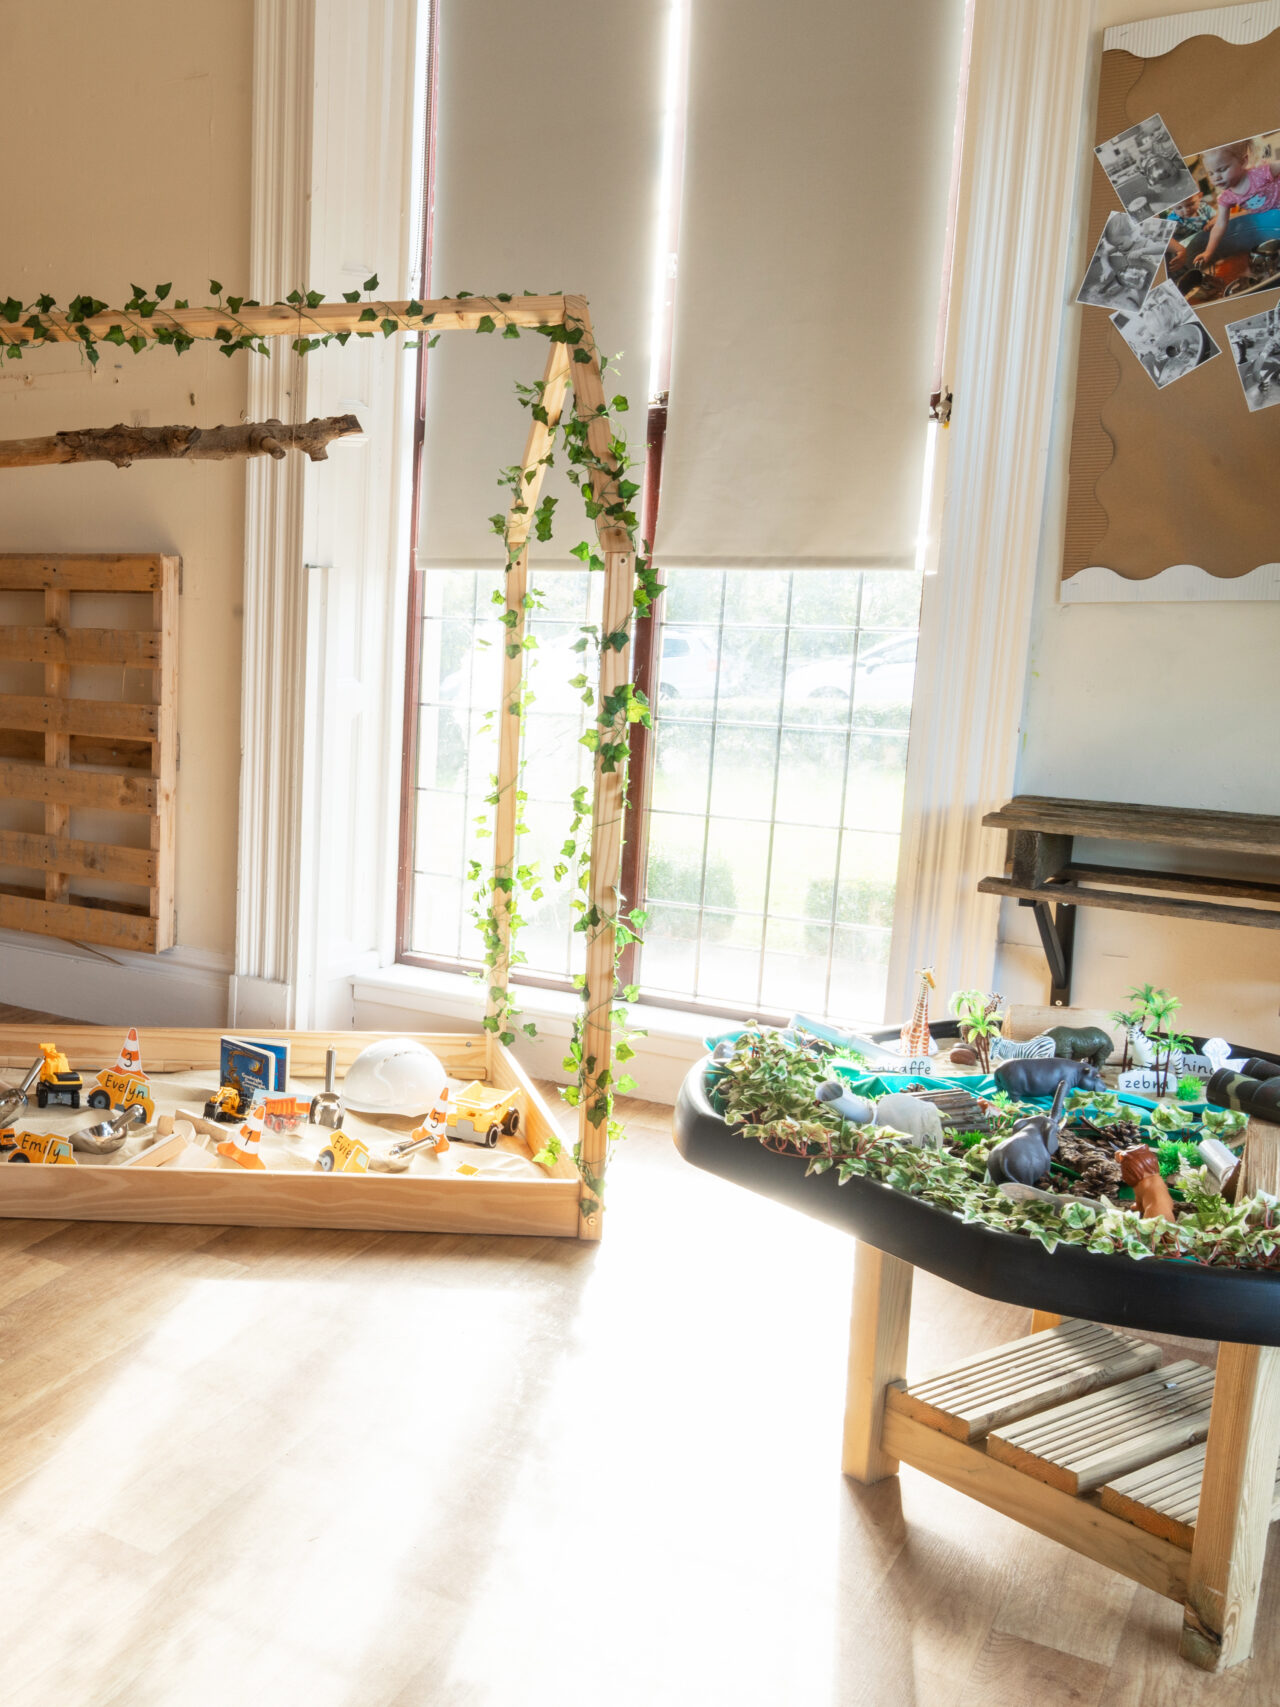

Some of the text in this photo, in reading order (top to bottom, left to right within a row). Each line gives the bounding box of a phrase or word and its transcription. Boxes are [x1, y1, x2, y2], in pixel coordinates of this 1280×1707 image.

[124, 1052, 133, 1067] 3
[105, 1074, 145, 1102] Evelyn
[430, 1112, 439, 1129] 5
[244, 1130, 253, 1146] 1
[333, 1135, 352, 1160] Evie
[21, 1134, 61, 1164] Emily
